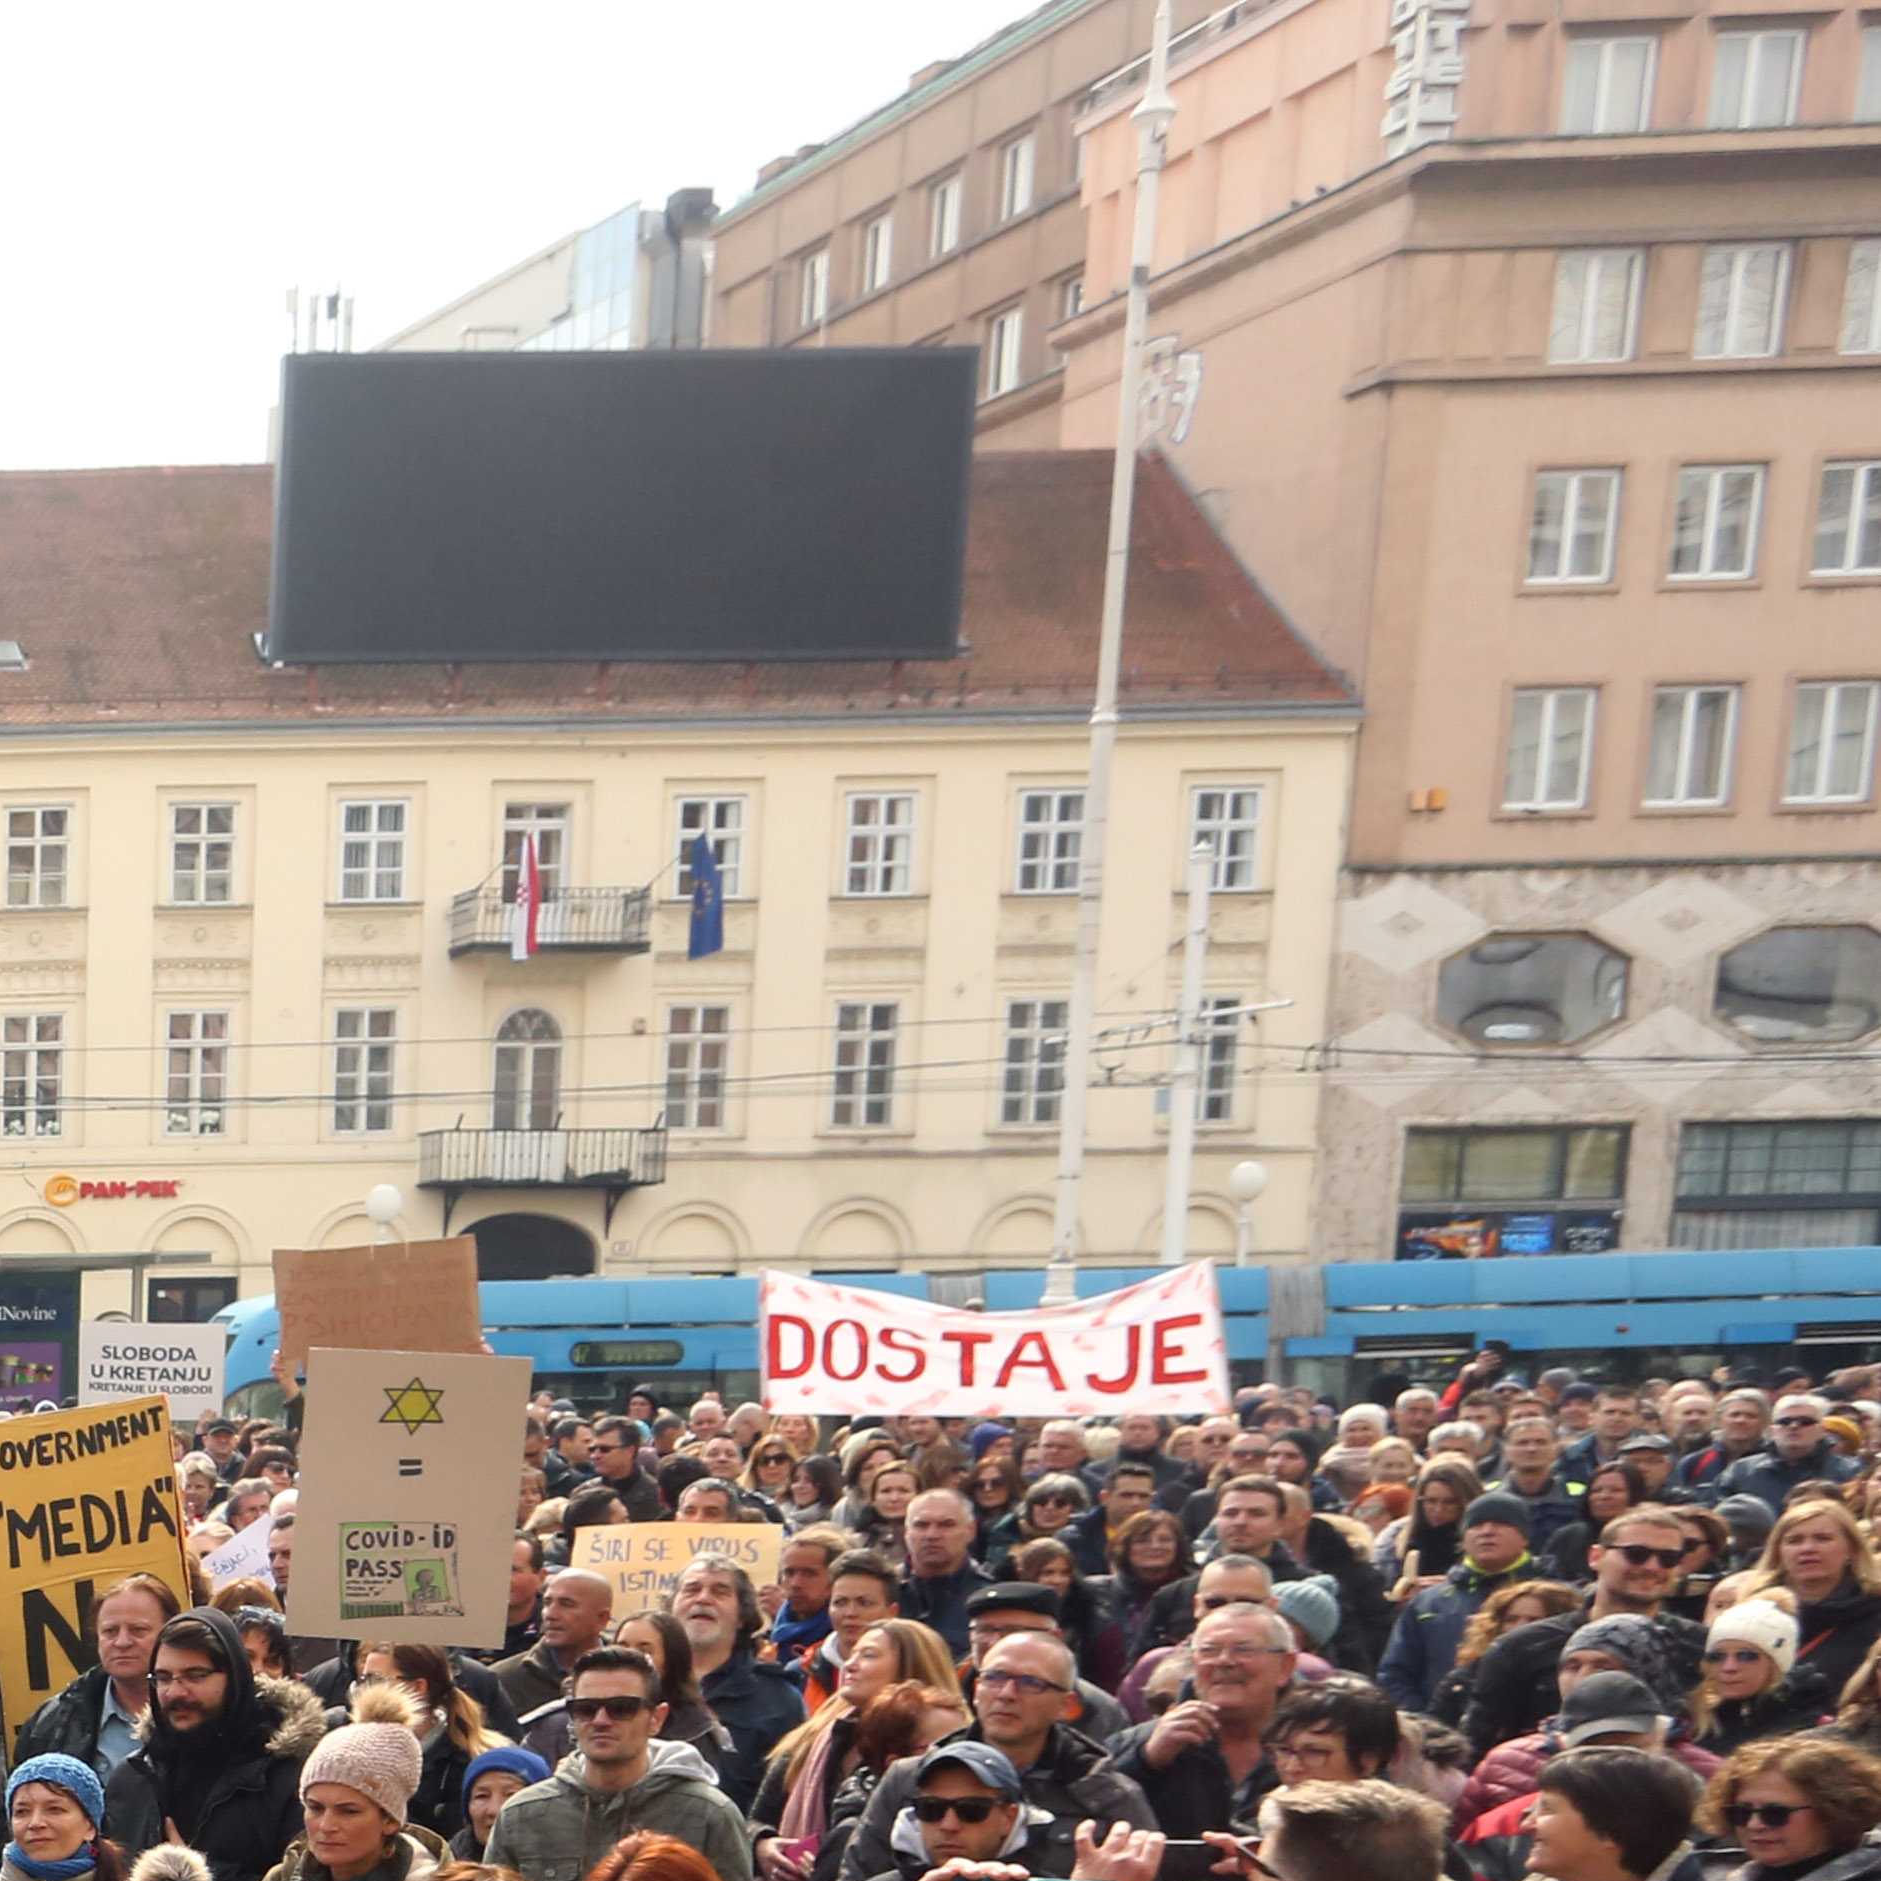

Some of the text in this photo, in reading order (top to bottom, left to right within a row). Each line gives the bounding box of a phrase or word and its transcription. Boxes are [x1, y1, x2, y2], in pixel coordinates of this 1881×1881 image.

[80, 1181, 179, 1199] PAN-PEK
[101, 1345, 197, 1361] SLOBODA
[90, 1364, 211, 1381] U KRETANJU
[88, 1381, 213, 1395] KRETANJE U SLOBODI
[589, 1533, 763, 1563] ŠIRI SE VIRUS
[345, 1558, 403, 1578] PASS
